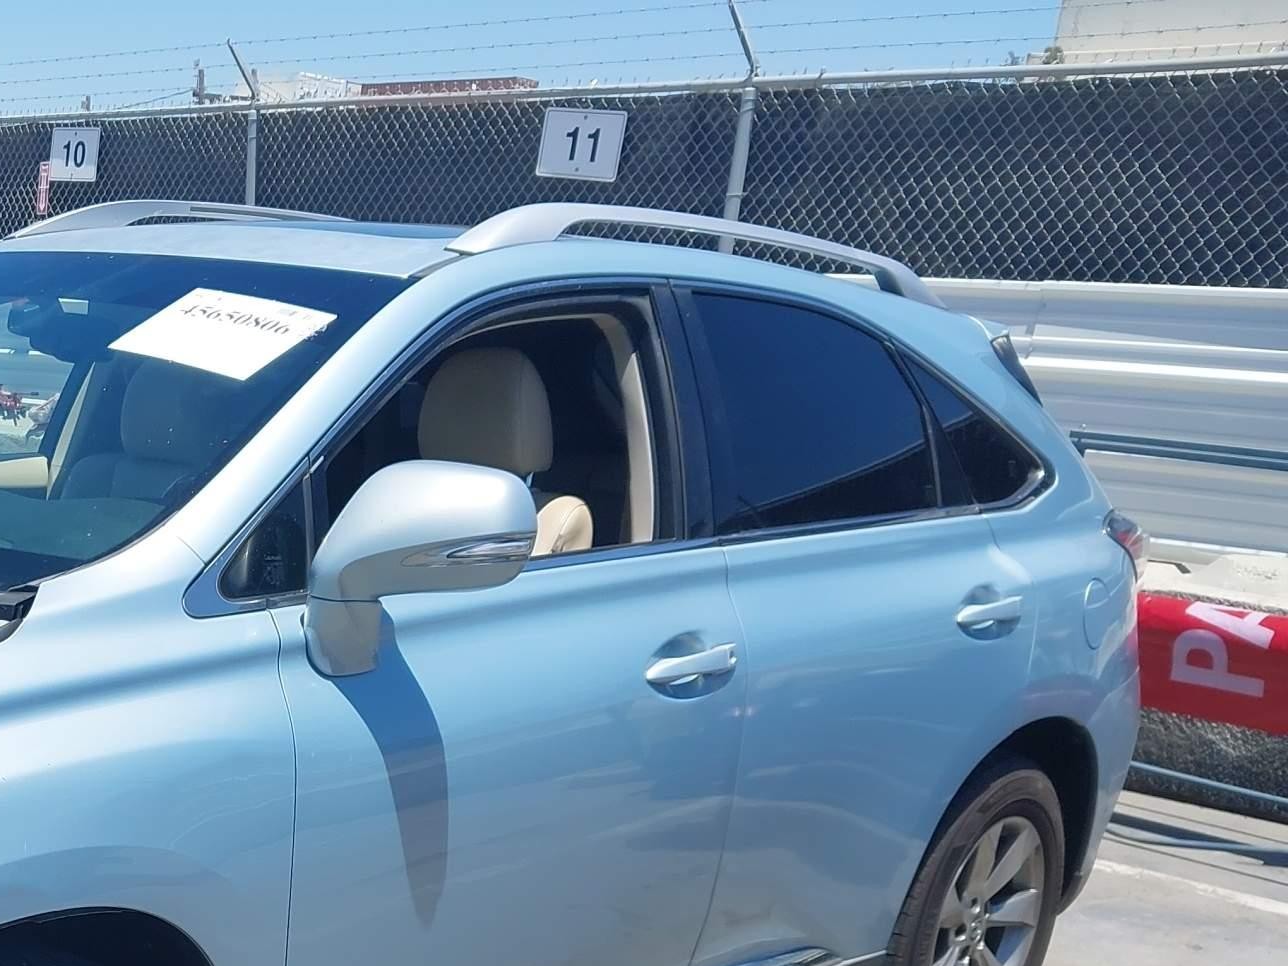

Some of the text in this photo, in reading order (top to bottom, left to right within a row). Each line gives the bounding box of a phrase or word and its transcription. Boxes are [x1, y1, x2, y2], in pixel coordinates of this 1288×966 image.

[62, 140, 86, 168] 10
[566, 126, 601, 163] 11
[180, 304, 290, 335] 45650806
